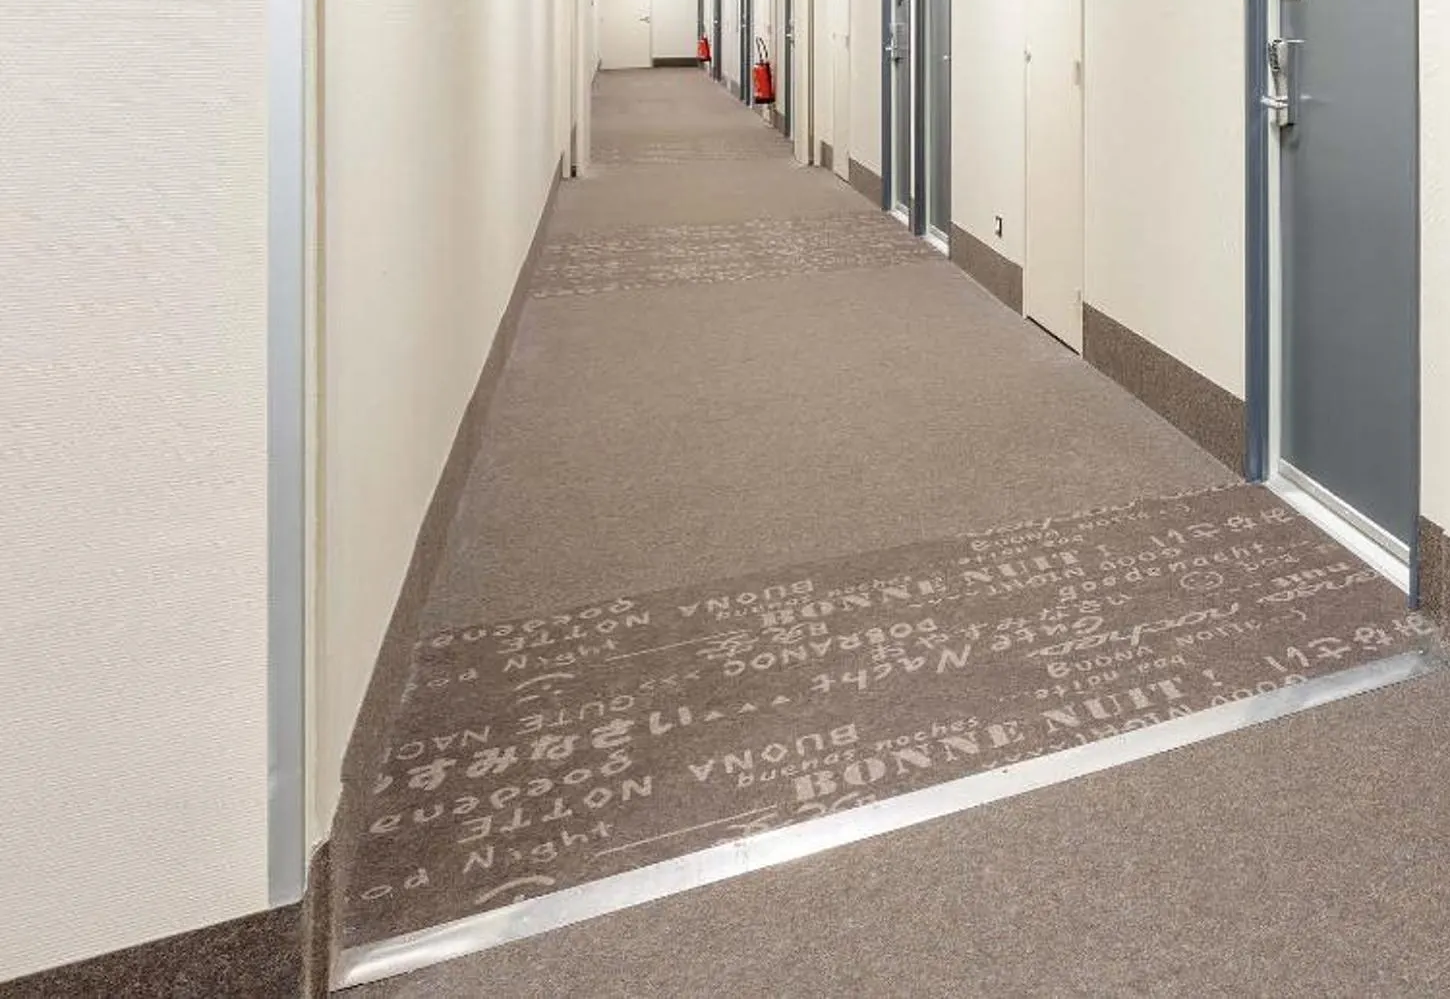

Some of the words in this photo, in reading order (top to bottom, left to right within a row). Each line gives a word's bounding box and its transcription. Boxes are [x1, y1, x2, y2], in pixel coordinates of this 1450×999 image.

[688, 722, 860, 784] BUONA
[791, 718, 1028, 803] BONNE
[1036, 674, 1194, 734] NUIT
[457, 773, 654, 845] NOTTE
[460, 813, 615, 886] Night
